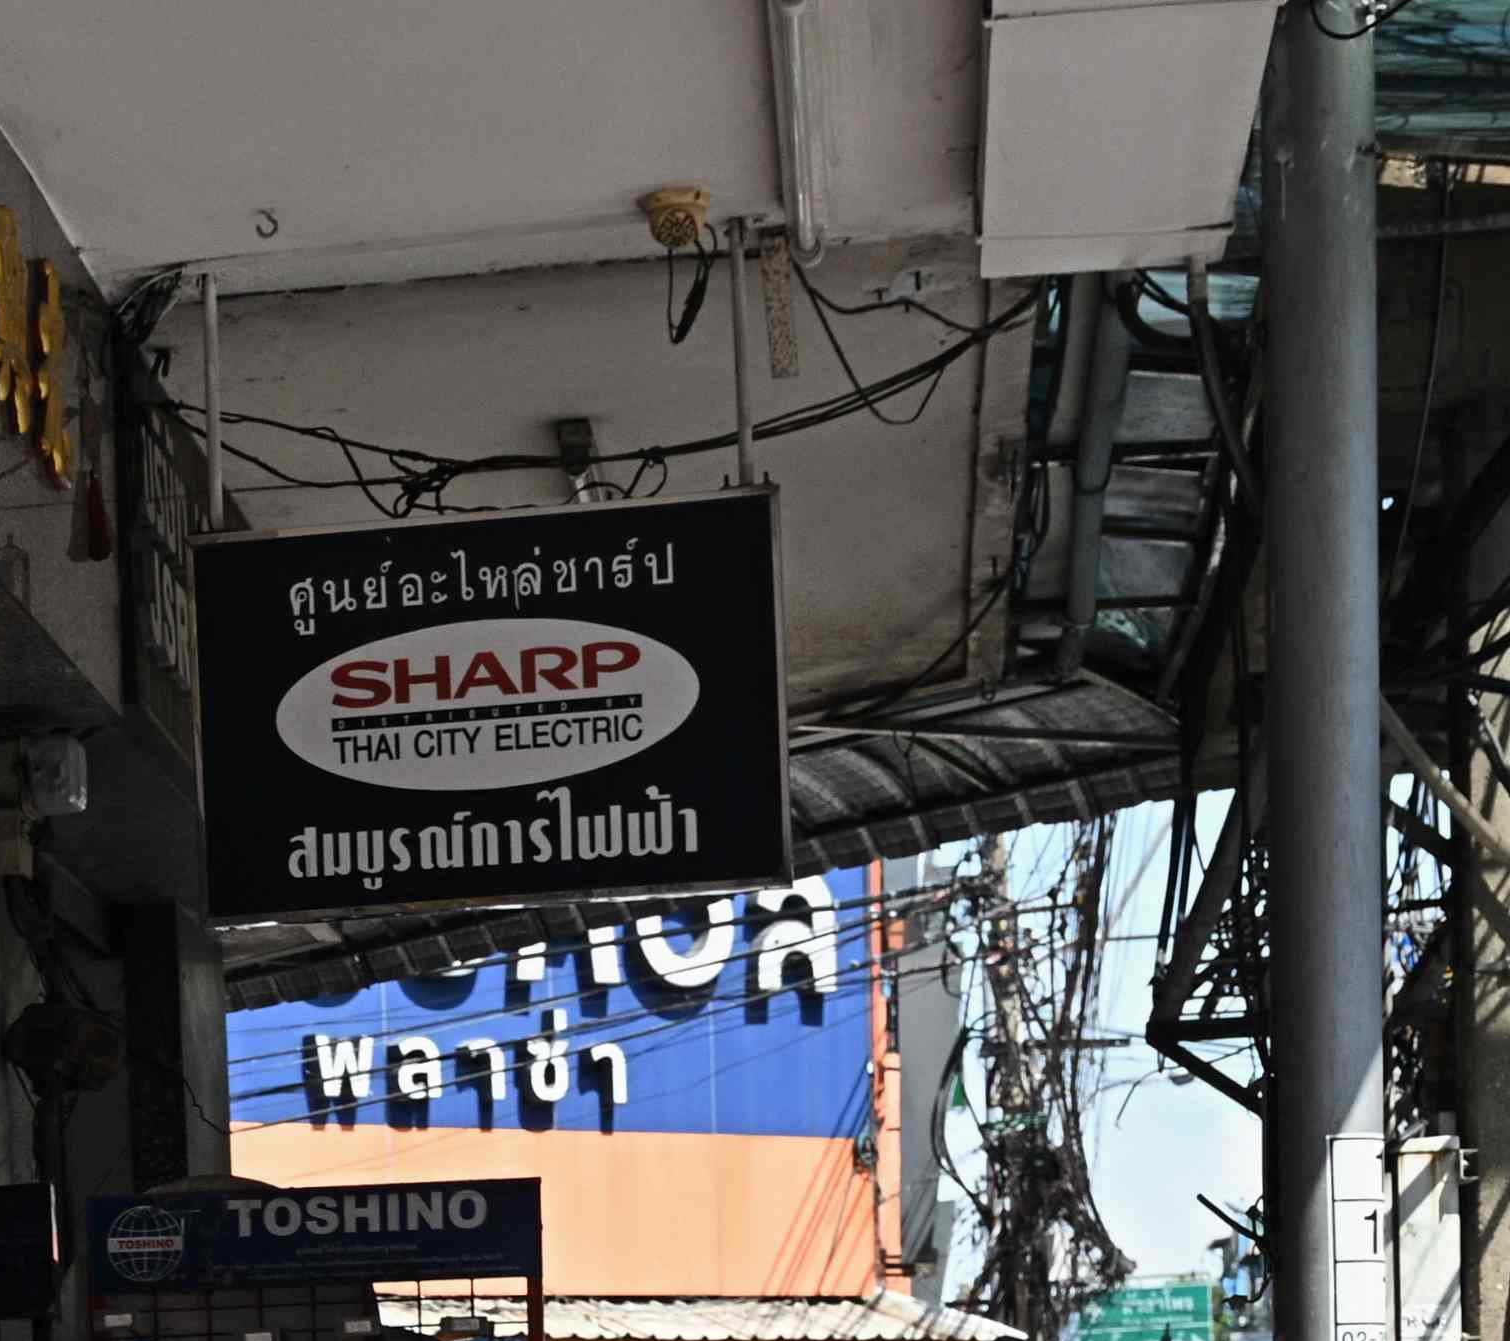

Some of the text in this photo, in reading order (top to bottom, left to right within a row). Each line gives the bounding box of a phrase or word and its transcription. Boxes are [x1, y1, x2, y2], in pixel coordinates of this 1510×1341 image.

[330, 640, 643, 711] SHARP
[332, 712, 644, 766] THAI CITY ELECTRIC
[286, 784, 700, 891] สมบูรณ์การไฟฟ้า
[227, 1189, 489, 1239] TOSHINO
[117, 1237, 175, 1251] TOSHINO
